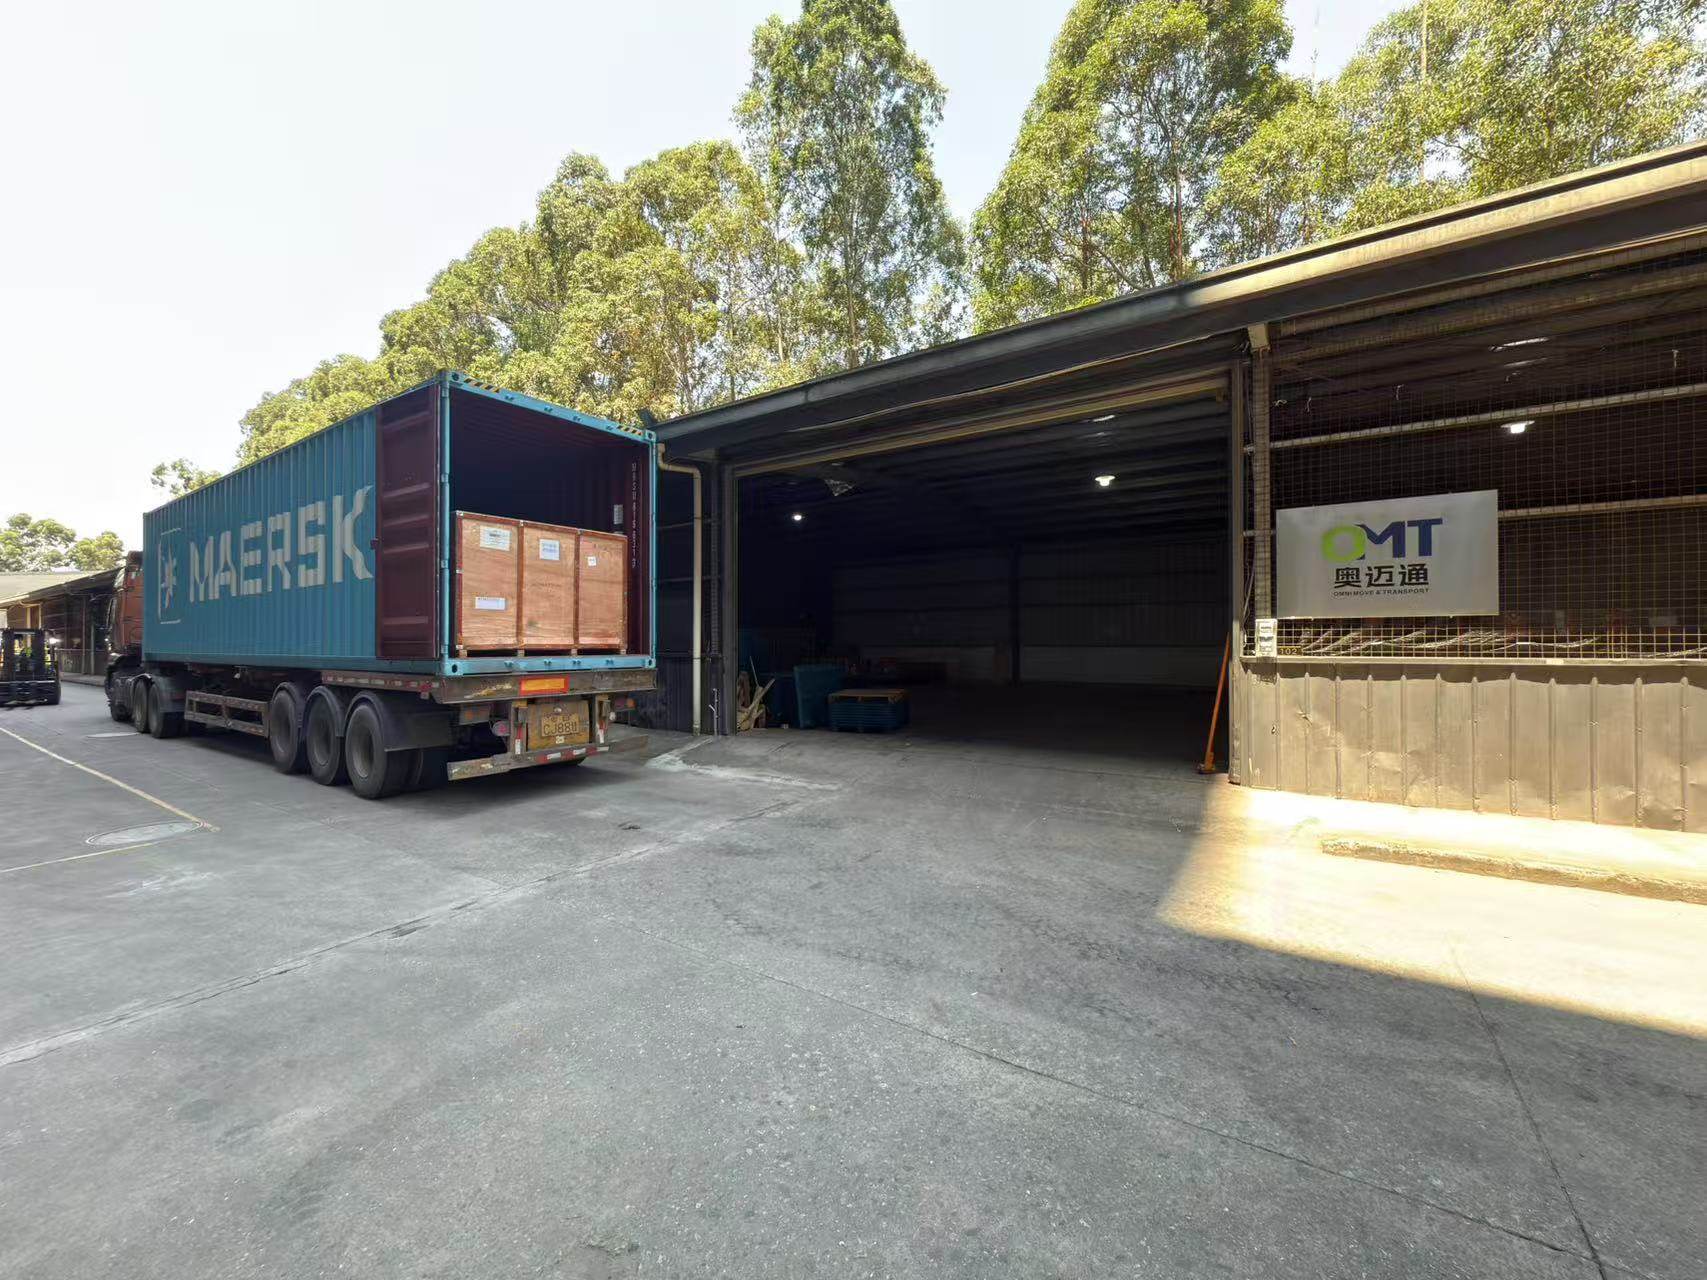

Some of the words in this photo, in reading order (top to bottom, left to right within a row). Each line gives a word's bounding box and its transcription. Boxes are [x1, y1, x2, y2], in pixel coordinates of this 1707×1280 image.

[189, 485, 374, 603] MAERSK
[1321, 517, 1443, 562] OMT
[1334, 563, 1429, 589] 奥迈通
